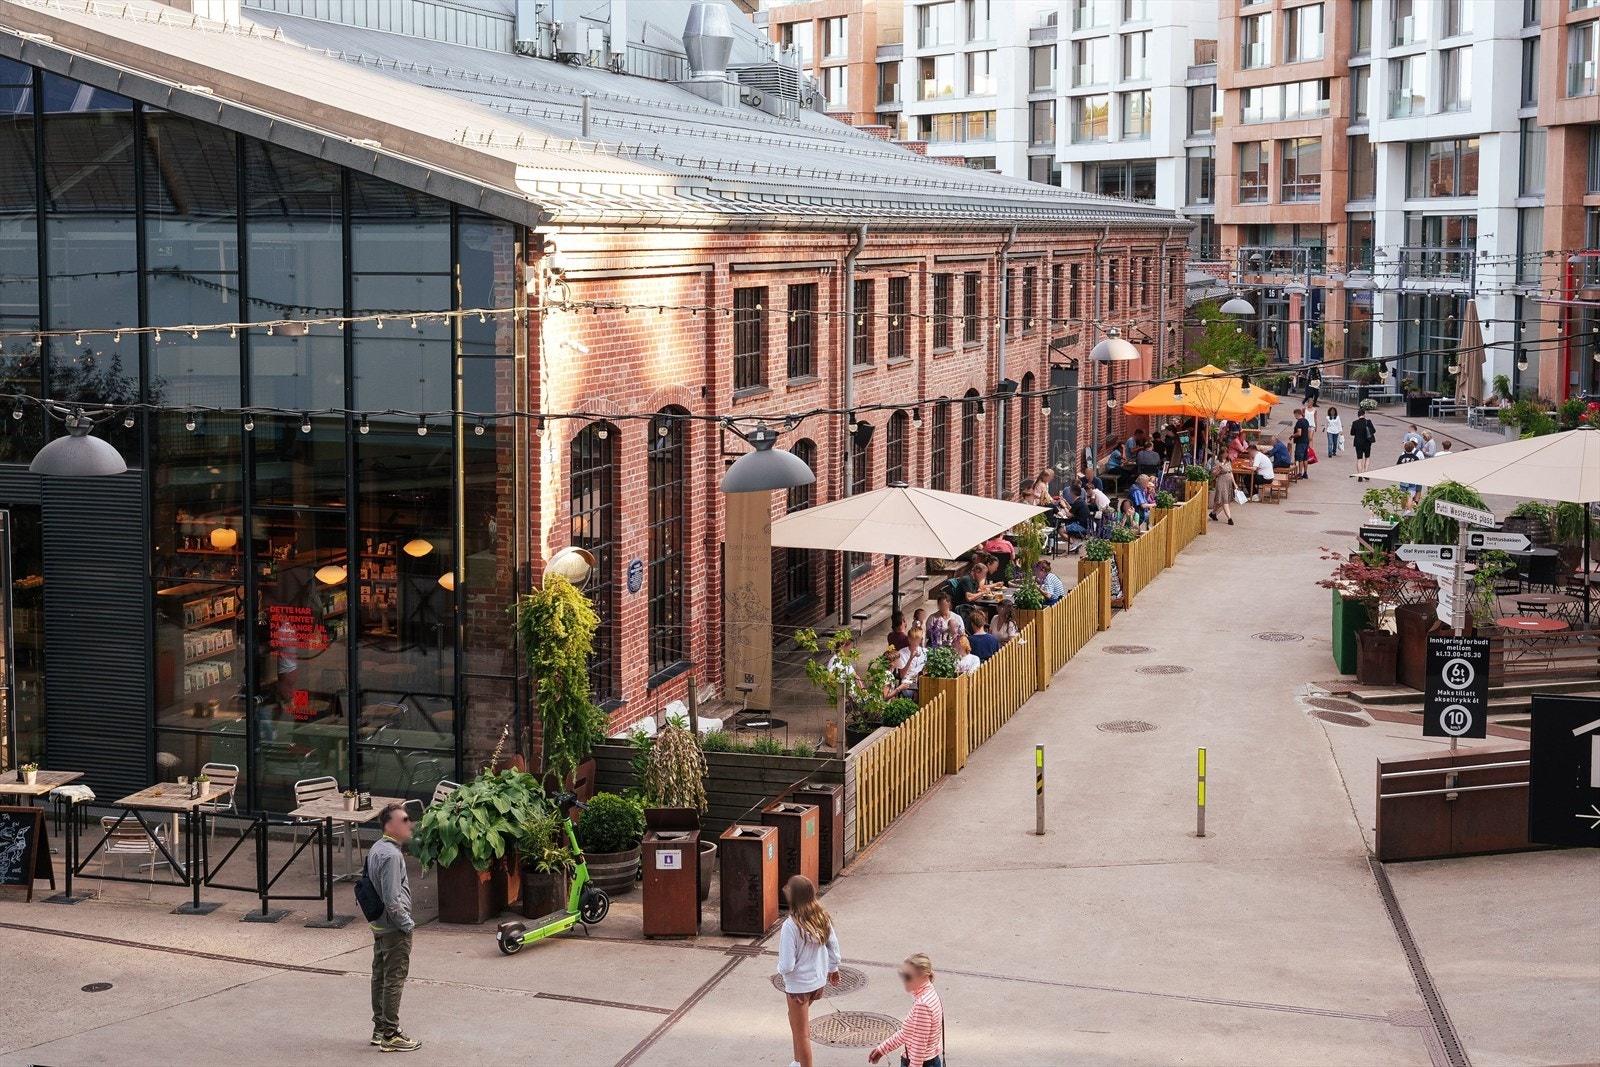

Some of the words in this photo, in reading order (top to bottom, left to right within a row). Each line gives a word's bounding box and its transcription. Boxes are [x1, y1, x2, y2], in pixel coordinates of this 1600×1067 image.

[1450, 506, 1478, 521] Westerdals
[1479, 514, 1493, 525] plass
[270, 606, 294, 614] DETTE
[295, 607, 312, 615] HAR
[285, 615, 315, 623] VENTET
[1429, 637, 1463, 646] Innkjøring
[1452, 664, 1465, 677] 6t
[1434, 696, 1472, 704] akseltrykk
[1448, 711, 1464, 725] 10
